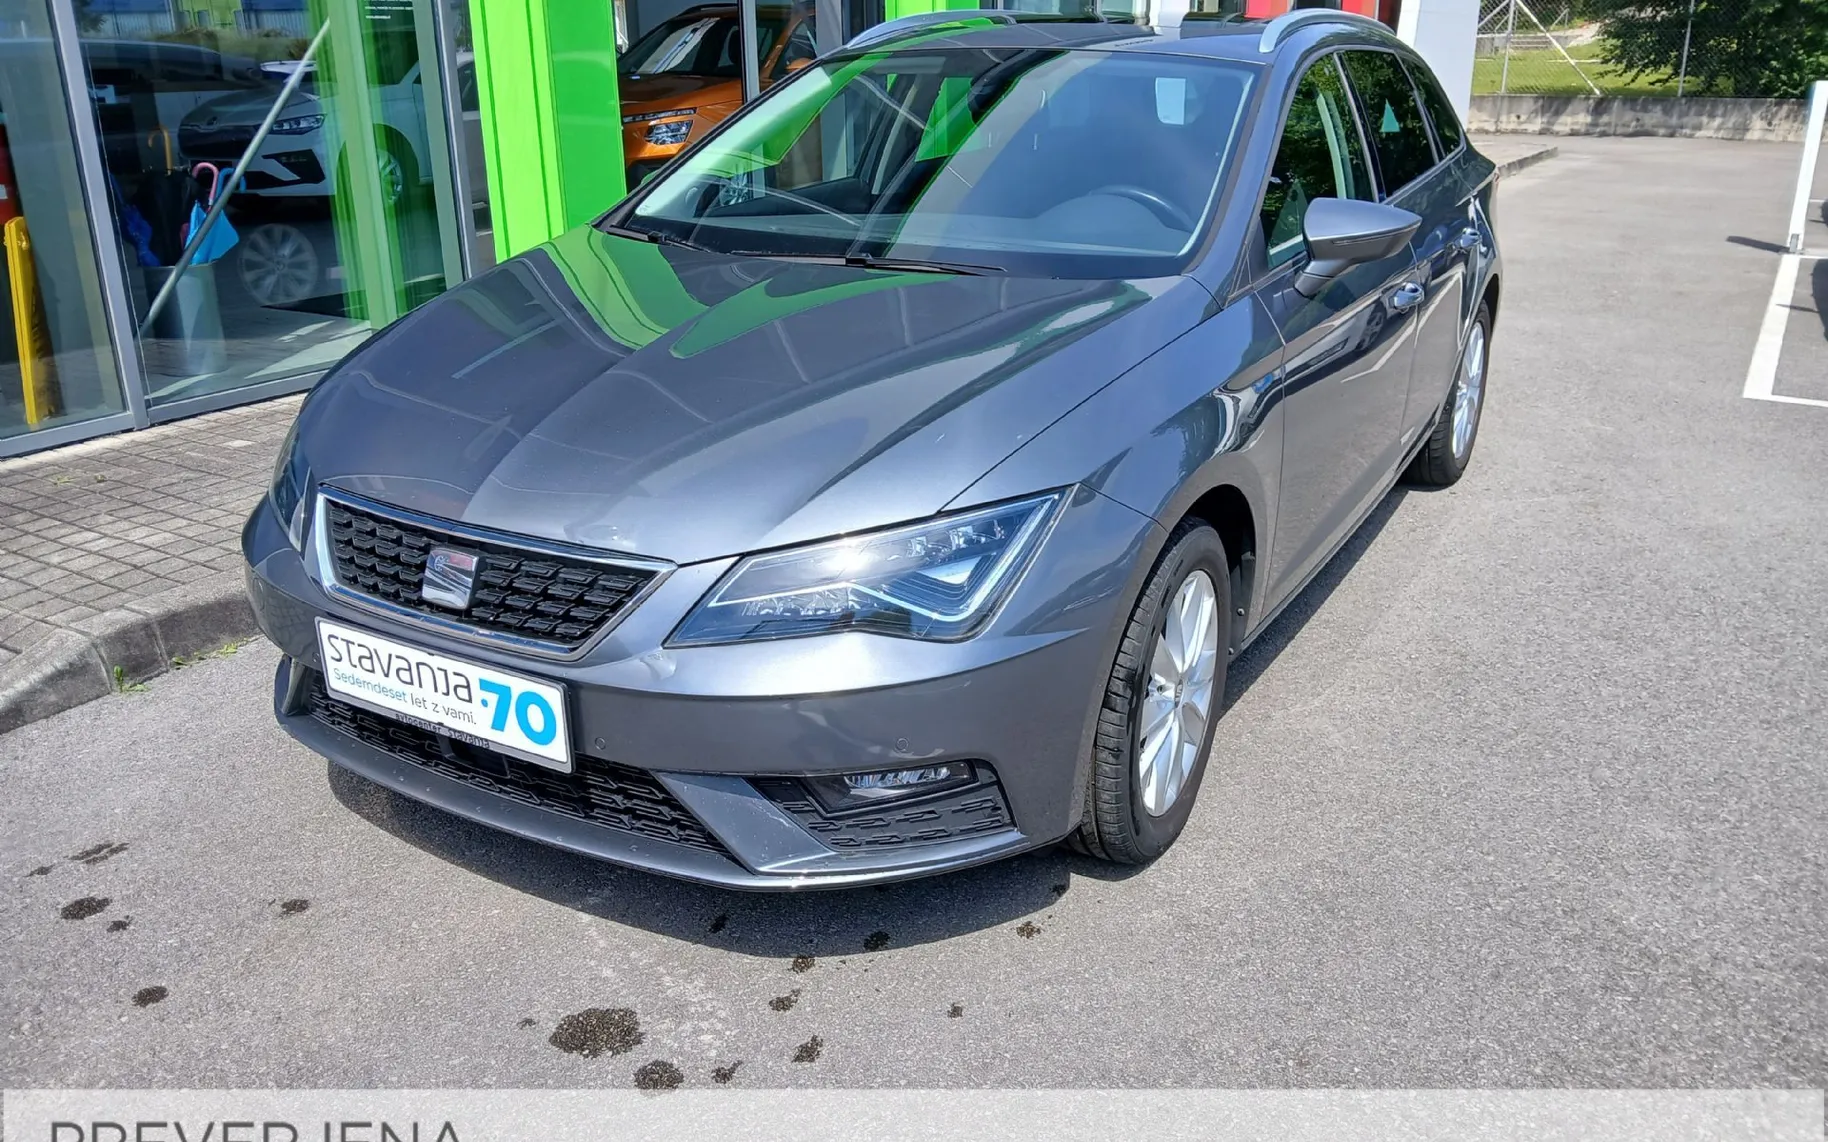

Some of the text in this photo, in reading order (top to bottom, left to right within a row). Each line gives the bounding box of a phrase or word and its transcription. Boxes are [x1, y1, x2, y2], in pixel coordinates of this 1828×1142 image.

[333, 667, 477, 725] Sedemdeset let z vami.
